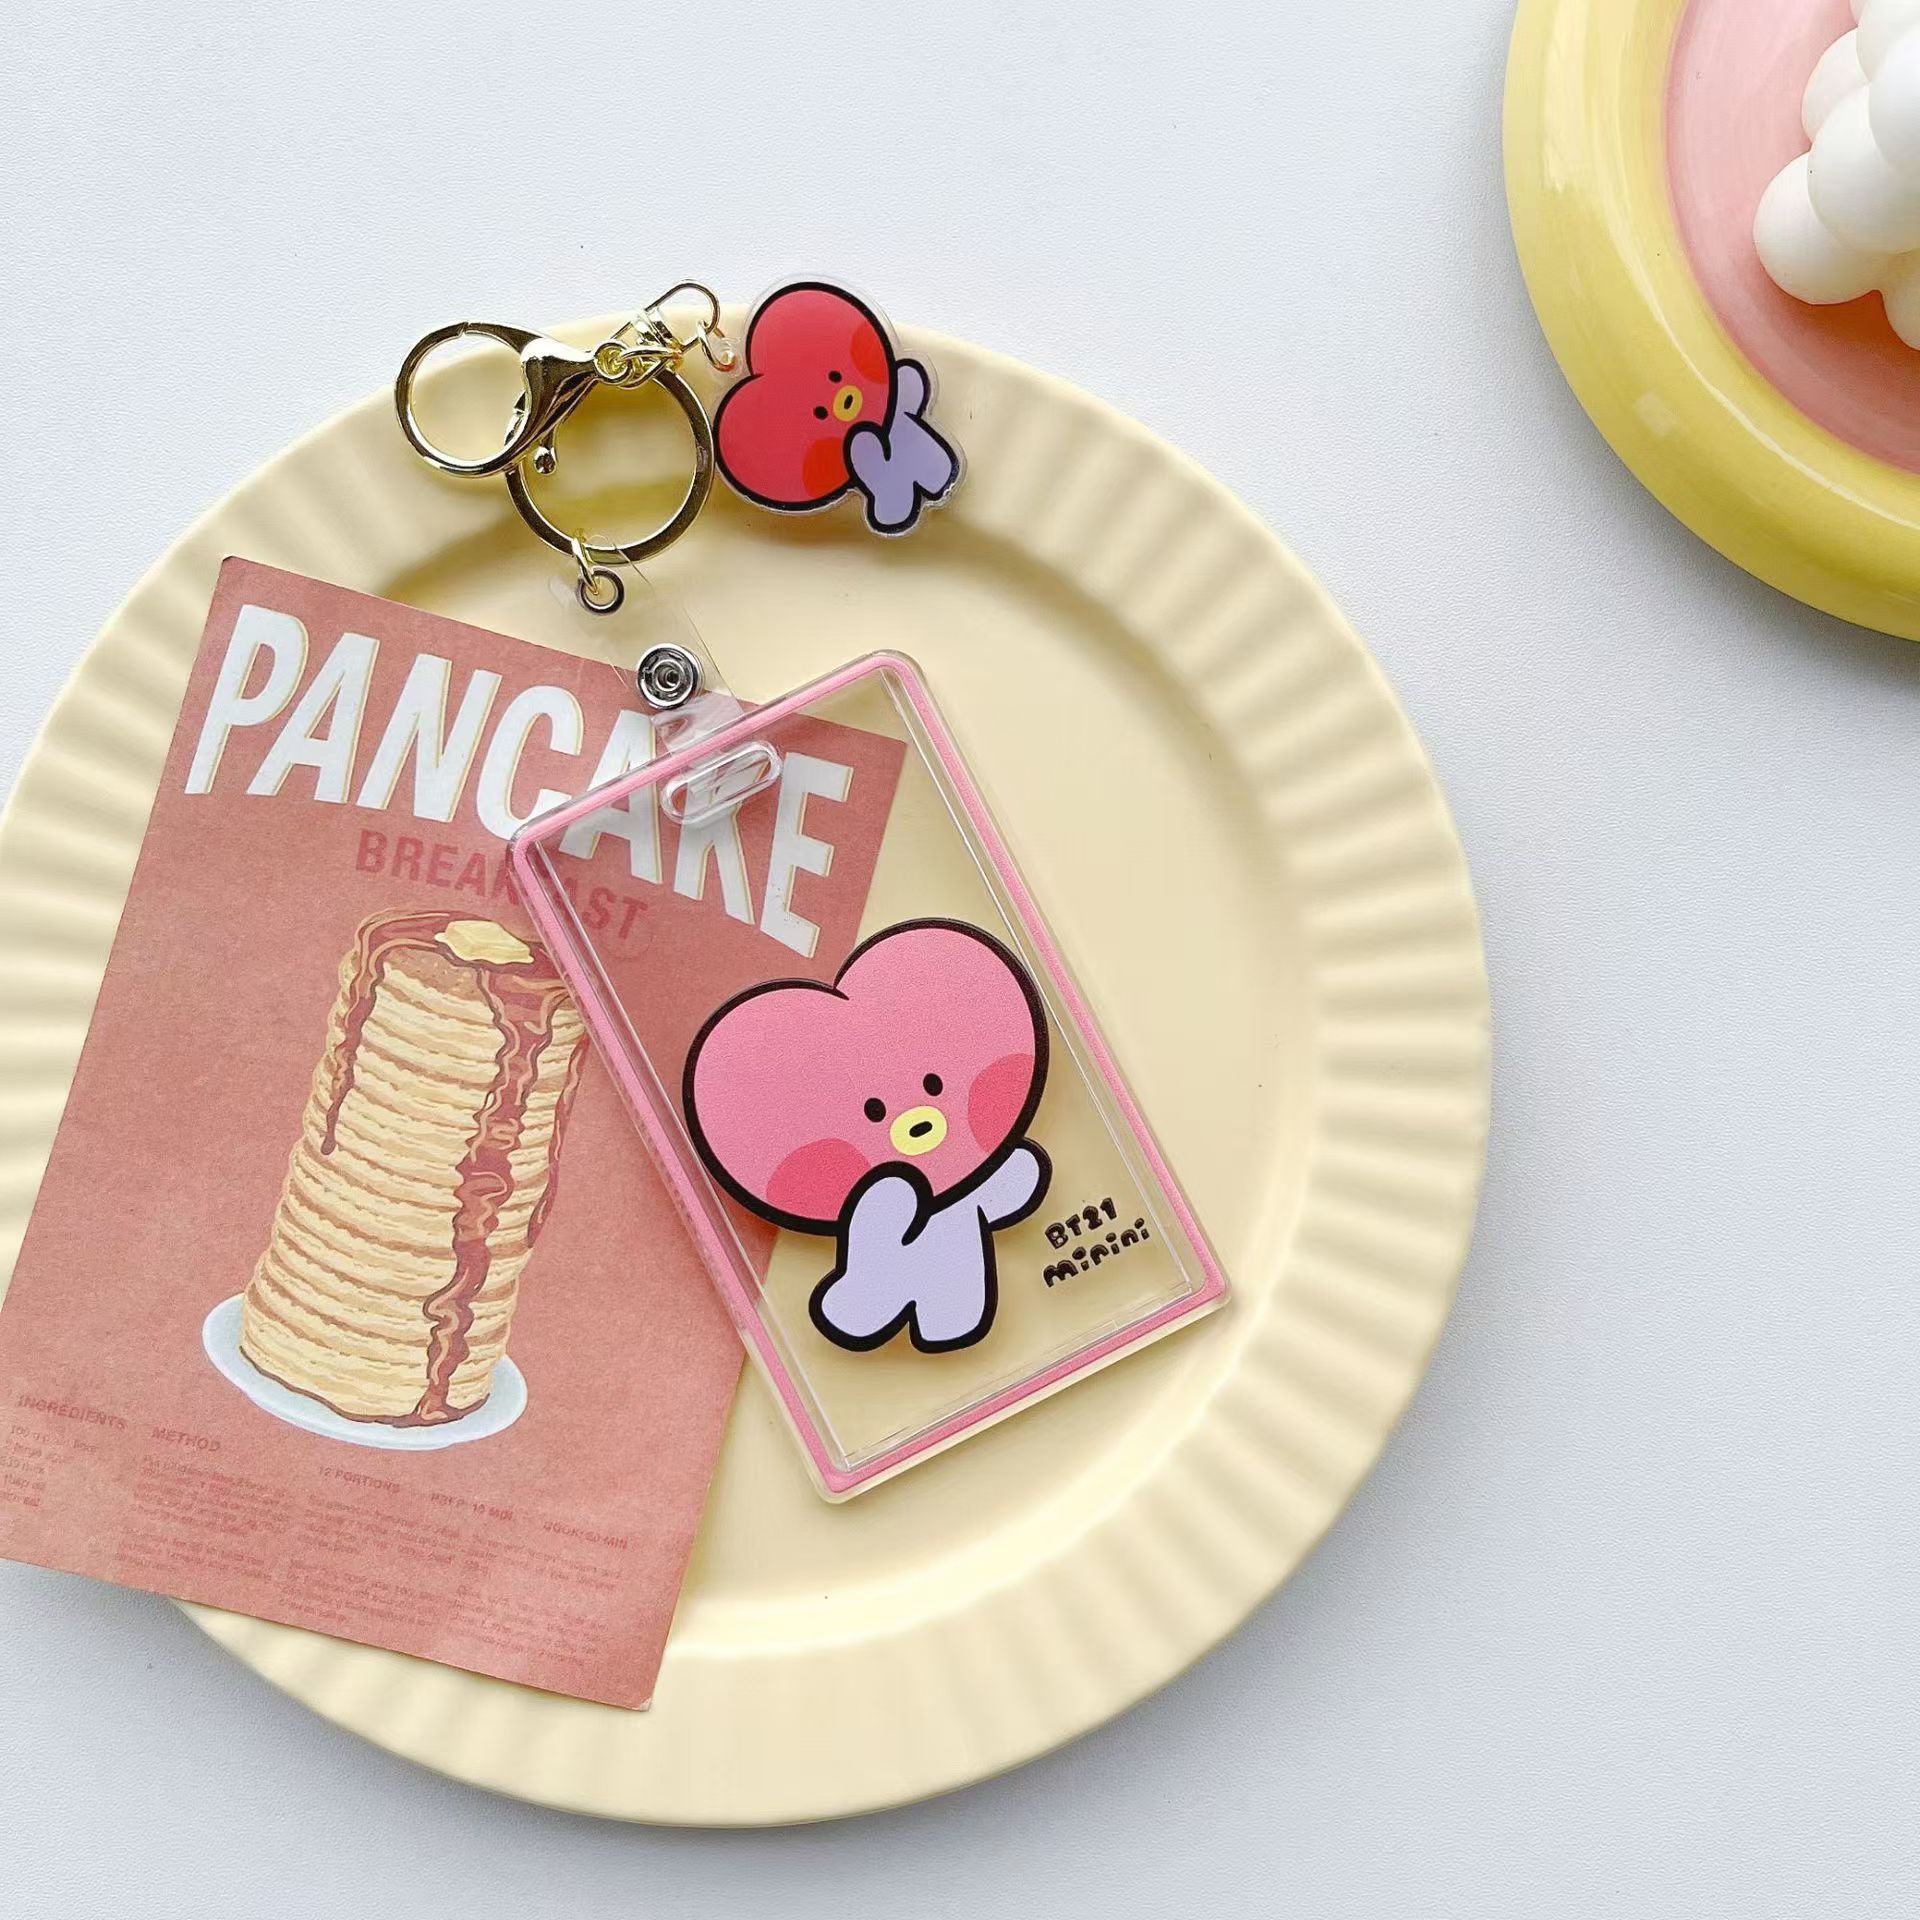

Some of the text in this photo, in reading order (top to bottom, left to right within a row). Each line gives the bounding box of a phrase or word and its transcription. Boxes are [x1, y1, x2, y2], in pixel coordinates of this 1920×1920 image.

[184, 604, 855, 958] PANCAKE
[355, 829, 649, 940] BREAKAST
[1045, 1197, 1117, 1250] BT21
[18, 1395, 126, 1430] INGREDIENTS
[151, 1426, 221, 1452] METHOD
